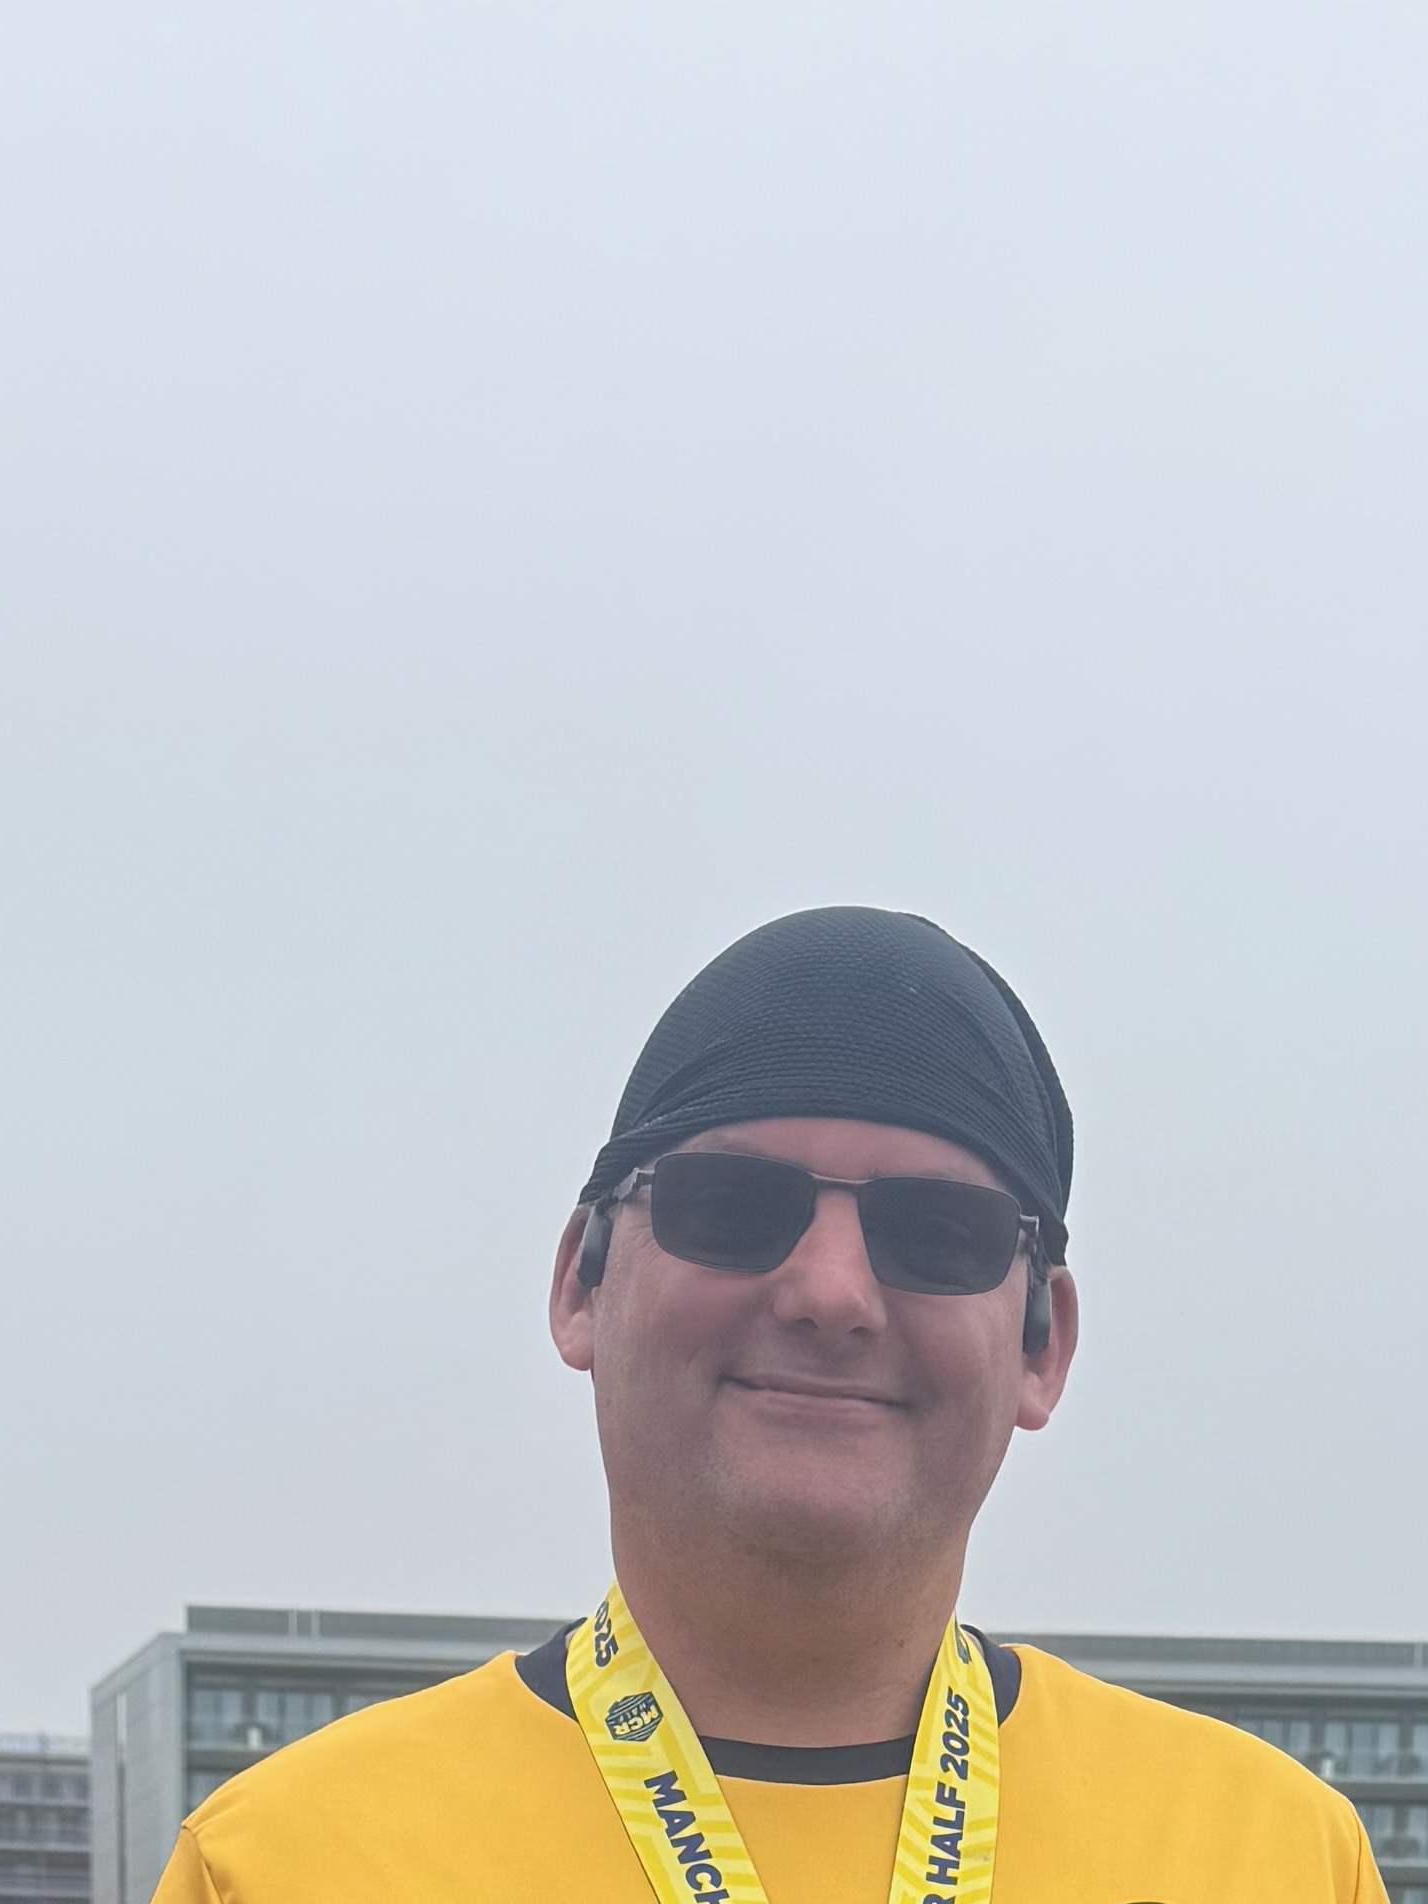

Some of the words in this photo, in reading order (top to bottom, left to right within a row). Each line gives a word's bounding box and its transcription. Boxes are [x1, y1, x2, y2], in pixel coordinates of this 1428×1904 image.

[595, 1600, 619, 1667] 025
[614, 1704, 659, 1736] MCR
[940, 1686, 970, 1780] 2025
[925, 1781, 966, 1885] HALF
